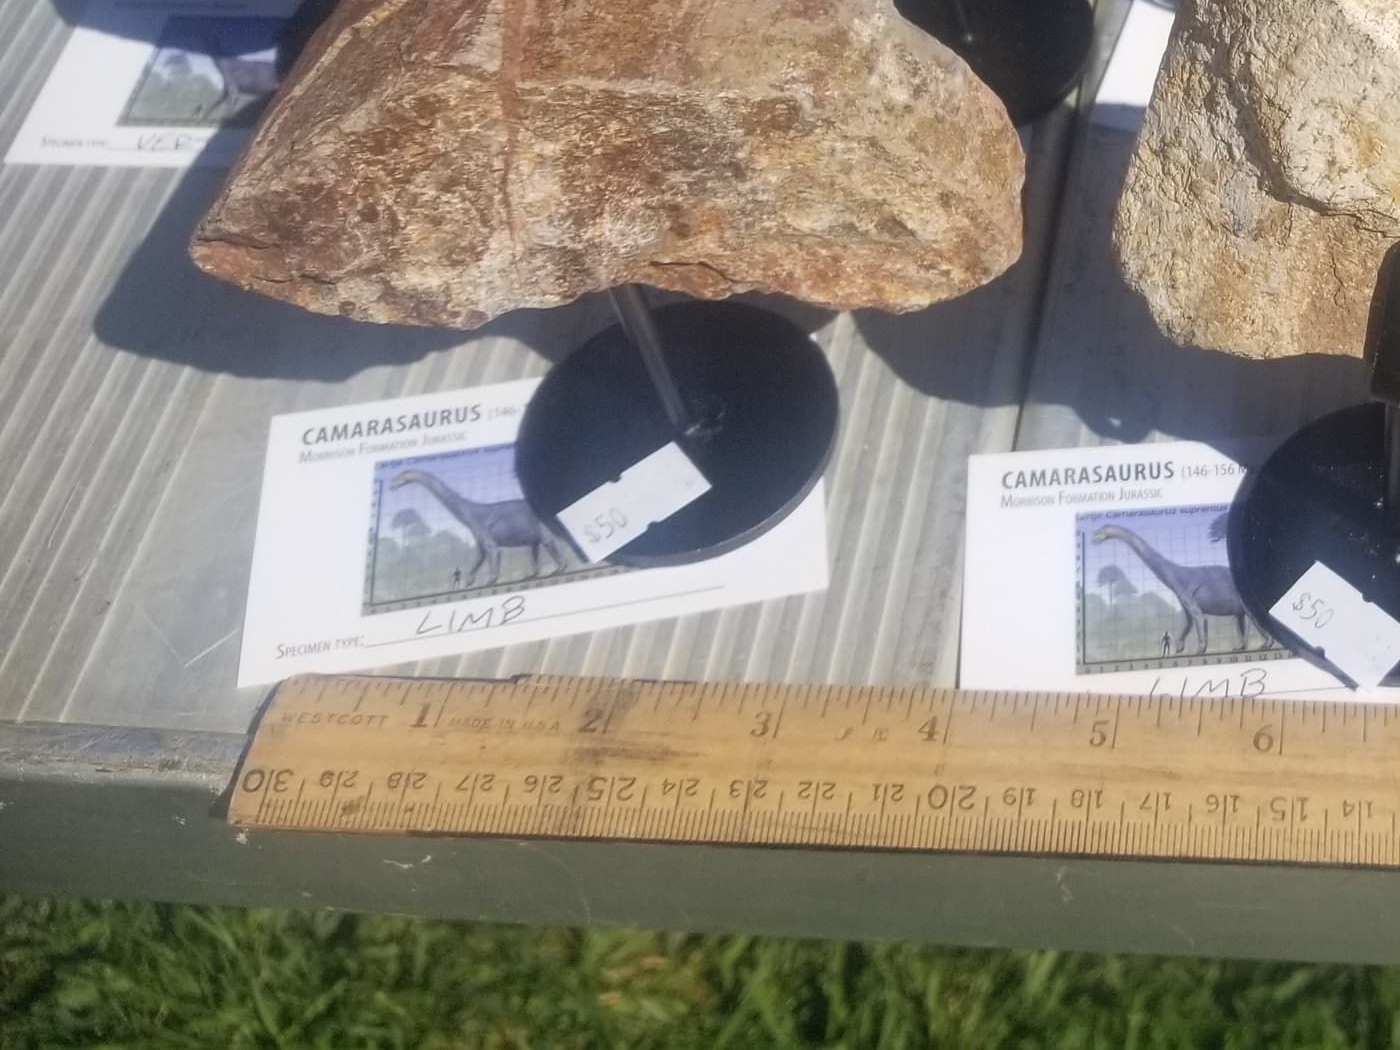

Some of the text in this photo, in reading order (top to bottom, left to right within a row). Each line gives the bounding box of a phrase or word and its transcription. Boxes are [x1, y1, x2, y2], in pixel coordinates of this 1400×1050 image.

[302, 404, 481, 446] CAMARASAURUS
[1002, 461, 1175, 490] CAMARASAURUS
[416, 595, 526, 636] LIMB
[1292, 591, 1334, 629] $50
[276, 640, 331, 660] SPECIMEN
[281, 712, 389, 727] WESTCOTT
[410, 703, 431, 728] 1
[578, 708, 604, 734] 2
[750, 710, 773, 738] 3
[917, 715, 940, 742] 4
[1089, 719, 1109, 748] 5
[1252, 724, 1274, 752] 6
[242, 768, 296, 793] 30
[319, 770, 360, 789] 29
[387, 771, 428, 790] 28
[455, 773, 496, 792] 27
[523, 775, 564, 794] 26
[587, 776, 637, 801] 25
[661, 778, 701, 797] 24
[728, 779, 769, 799] 23
[798, 781, 837, 800] 22
[871, 783, 905, 802] 21
[927, 784, 977, 811] 20
[1002, 787, 1037, 807] 19
[1070, 789, 1104, 809] 18
[1139, 792, 1173, 811] 17
[1206, 793, 1241, 814] 16
[1269, 796, 1309, 822] 15
[1342, 799, 1375, 819] 14
